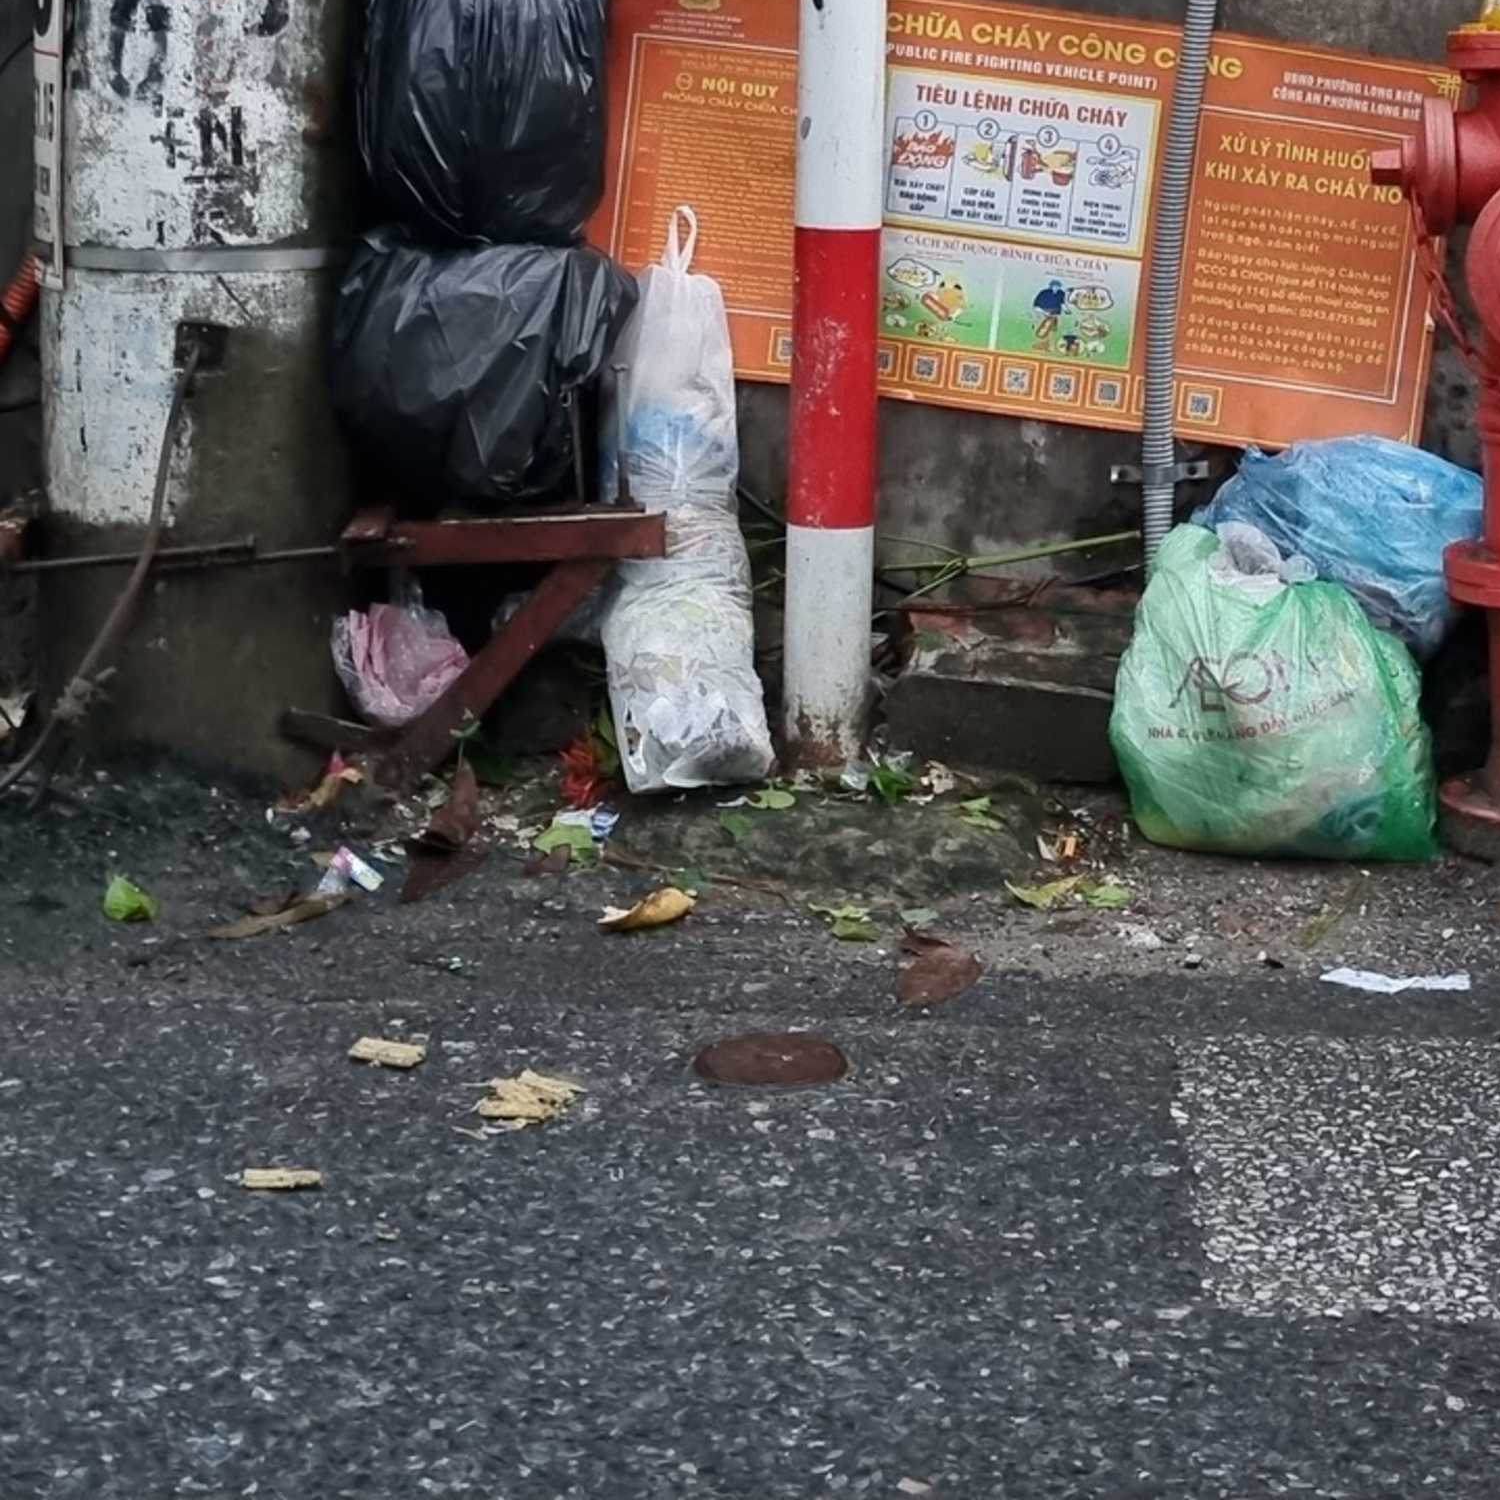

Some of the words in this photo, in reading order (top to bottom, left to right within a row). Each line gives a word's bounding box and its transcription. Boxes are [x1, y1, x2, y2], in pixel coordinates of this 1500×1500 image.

[971, 23, 1052, 52] CHÁY
[1058, 32, 1147, 65] CÔNG
[1154, 46, 1243, 79] CNG
[701, 74, 735, 94] NỘI
[740, 82, 778, 99] QUY
[940, 49, 972, 65] FIRE
[976, 54, 1042, 74] FIGHTING
[1044, 62, 1105, 83] VEHICLE
[1108, 71, 1158, 91] POINT)
[962, 87, 1015, 117] LỆNH
[1021, 95, 1071, 120] CHỮA
[1075, 102, 1128, 128] CHÁY
[1272, 86, 1304, 101] CÔNG
[1305, 91, 1321, 103] AN
[1370, 102, 1399, 117] LONG
[1401, 107, 1421, 120] BIÊ
[1363, 84, 1393, 99] LONG
[922, 114, 928, 126] 1
[984, 123, 993, 135] 2
[1043, 130, 1052, 143] 3
[1219, 129, 1248, 153] XỬ
[1249, 133, 1272, 157] LÝ
[1274, 139, 1319, 164] TÌNH
[1204, 161, 1237, 180] KHI
[1240, 162, 1281, 187] XẢY
[1285, 173, 1310, 191] RA
[1313, 173, 1369, 199] CHÁY
